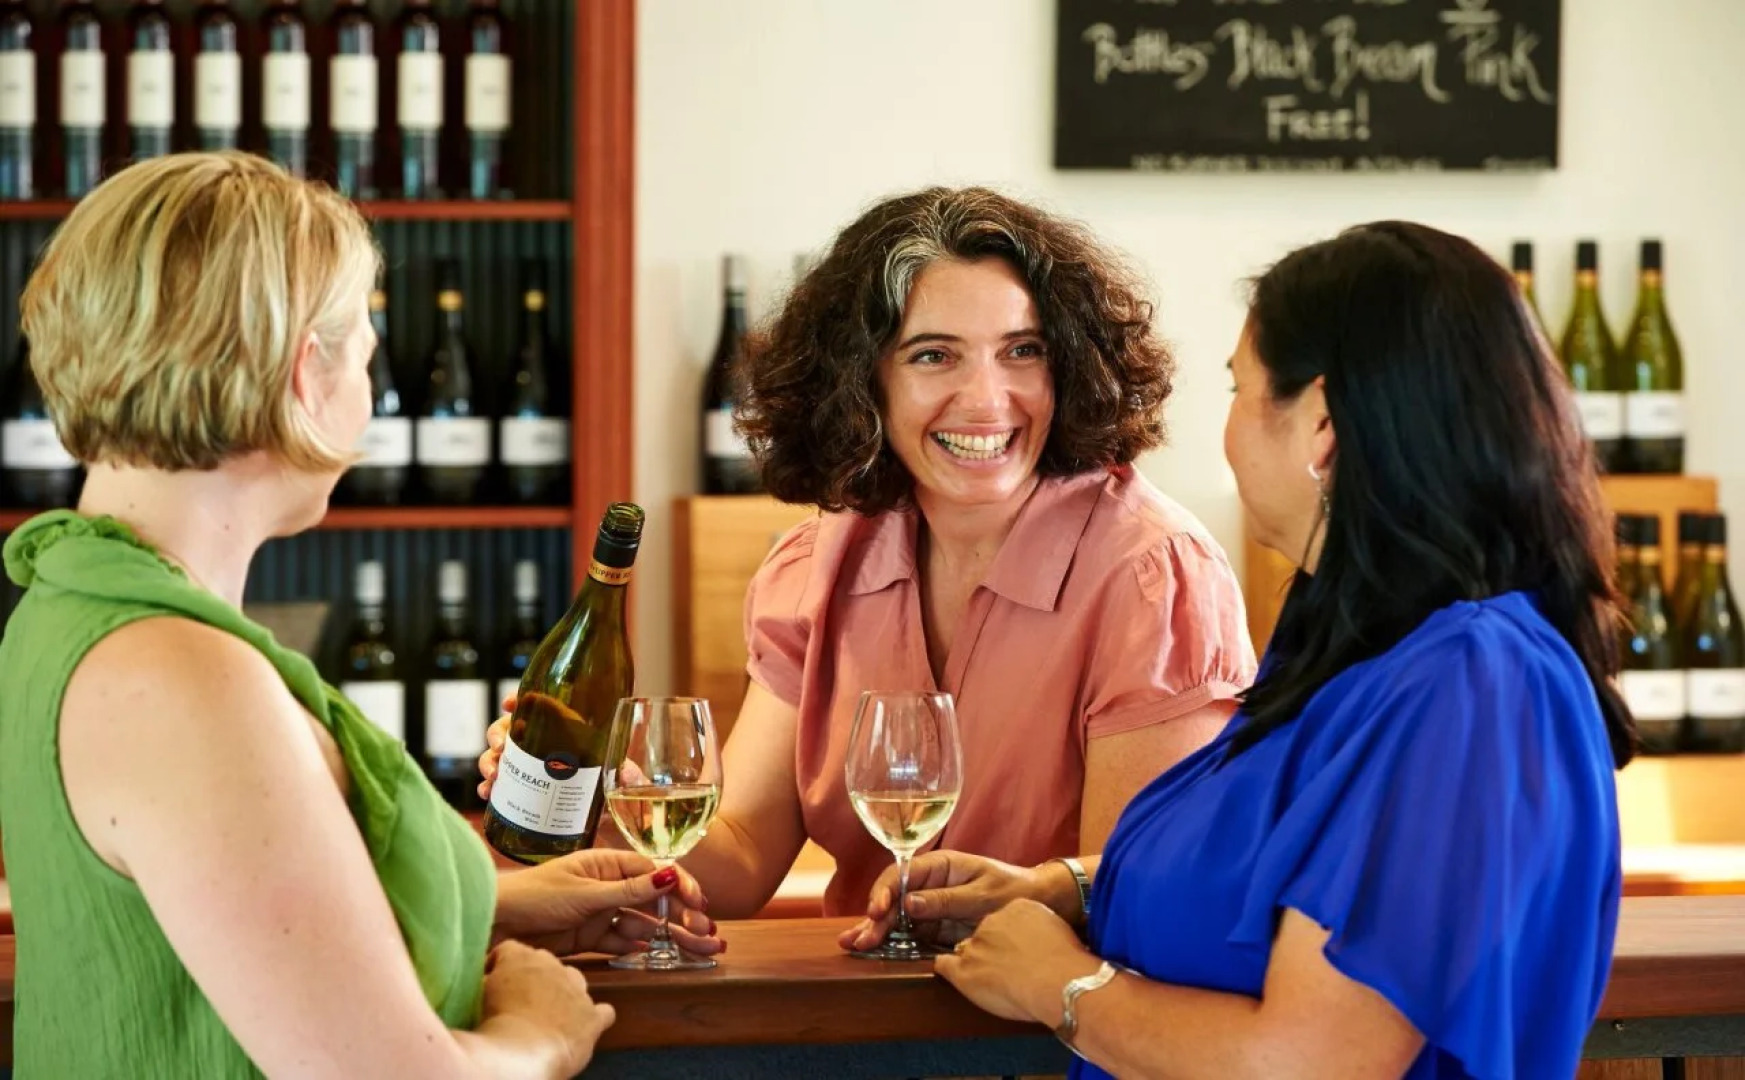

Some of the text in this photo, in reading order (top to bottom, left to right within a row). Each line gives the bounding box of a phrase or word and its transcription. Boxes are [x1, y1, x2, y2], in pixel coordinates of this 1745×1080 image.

[1081, 22, 1214, 91] Bottles
[1214, 18, 1323, 93] Black
[1448, 22, 1553, 105] Pink
[521, 772, 551, 790] REACH
